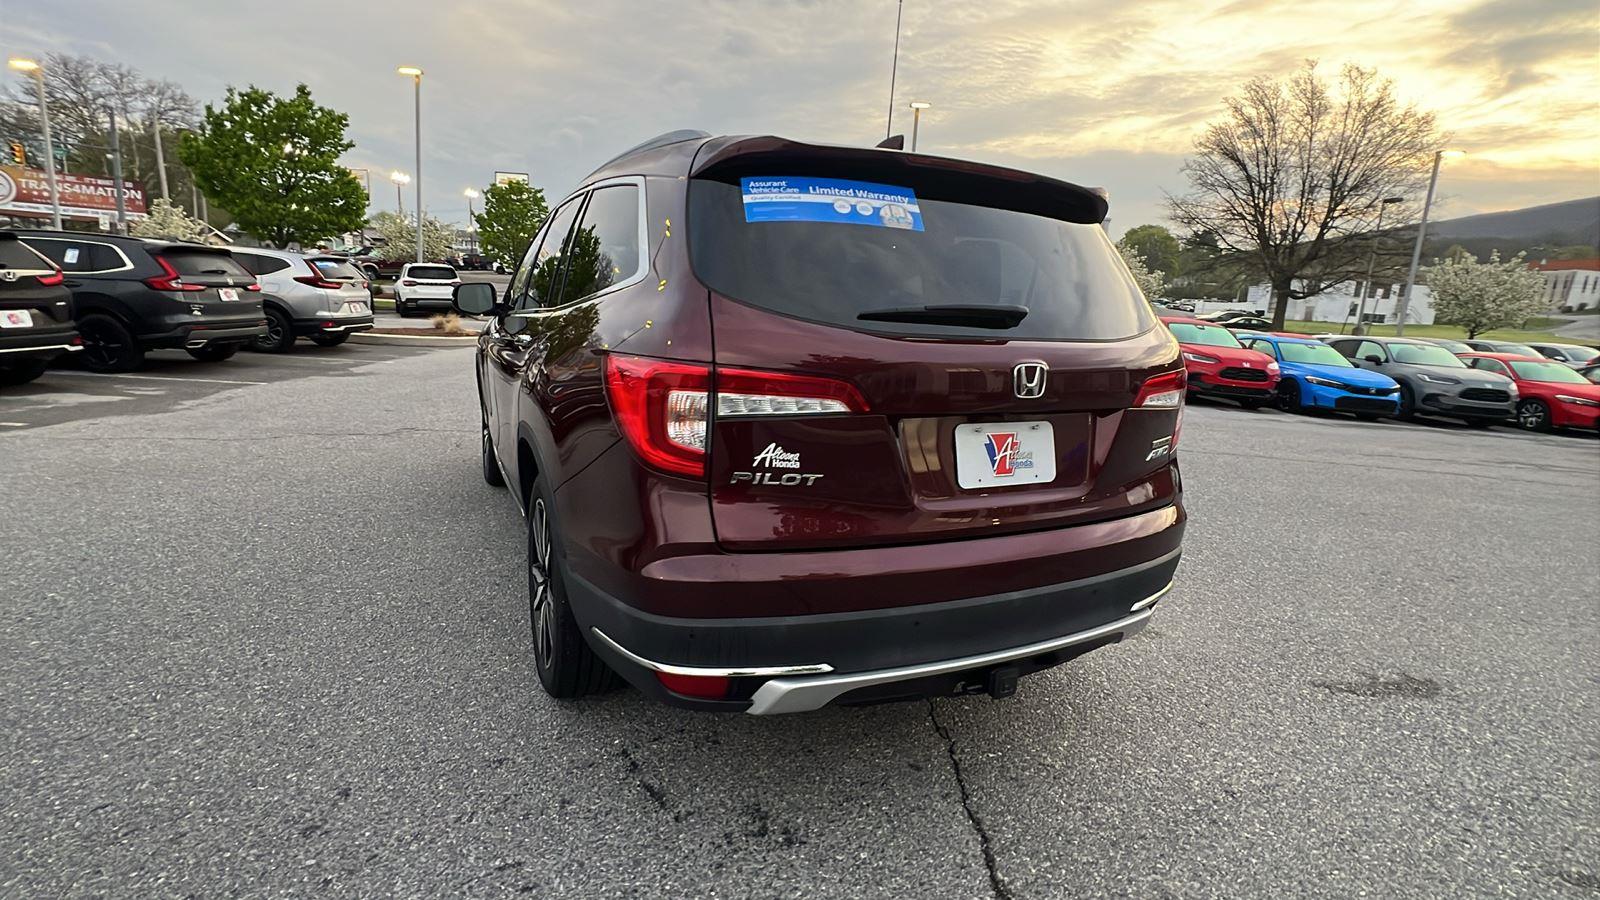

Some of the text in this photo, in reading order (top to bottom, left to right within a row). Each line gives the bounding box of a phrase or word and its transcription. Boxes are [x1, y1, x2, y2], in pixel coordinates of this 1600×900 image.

[808, 186, 909, 204] Limited Warranty
[772, 459, 800, 469] Honda
[730, 471, 824, 486] PILOT
